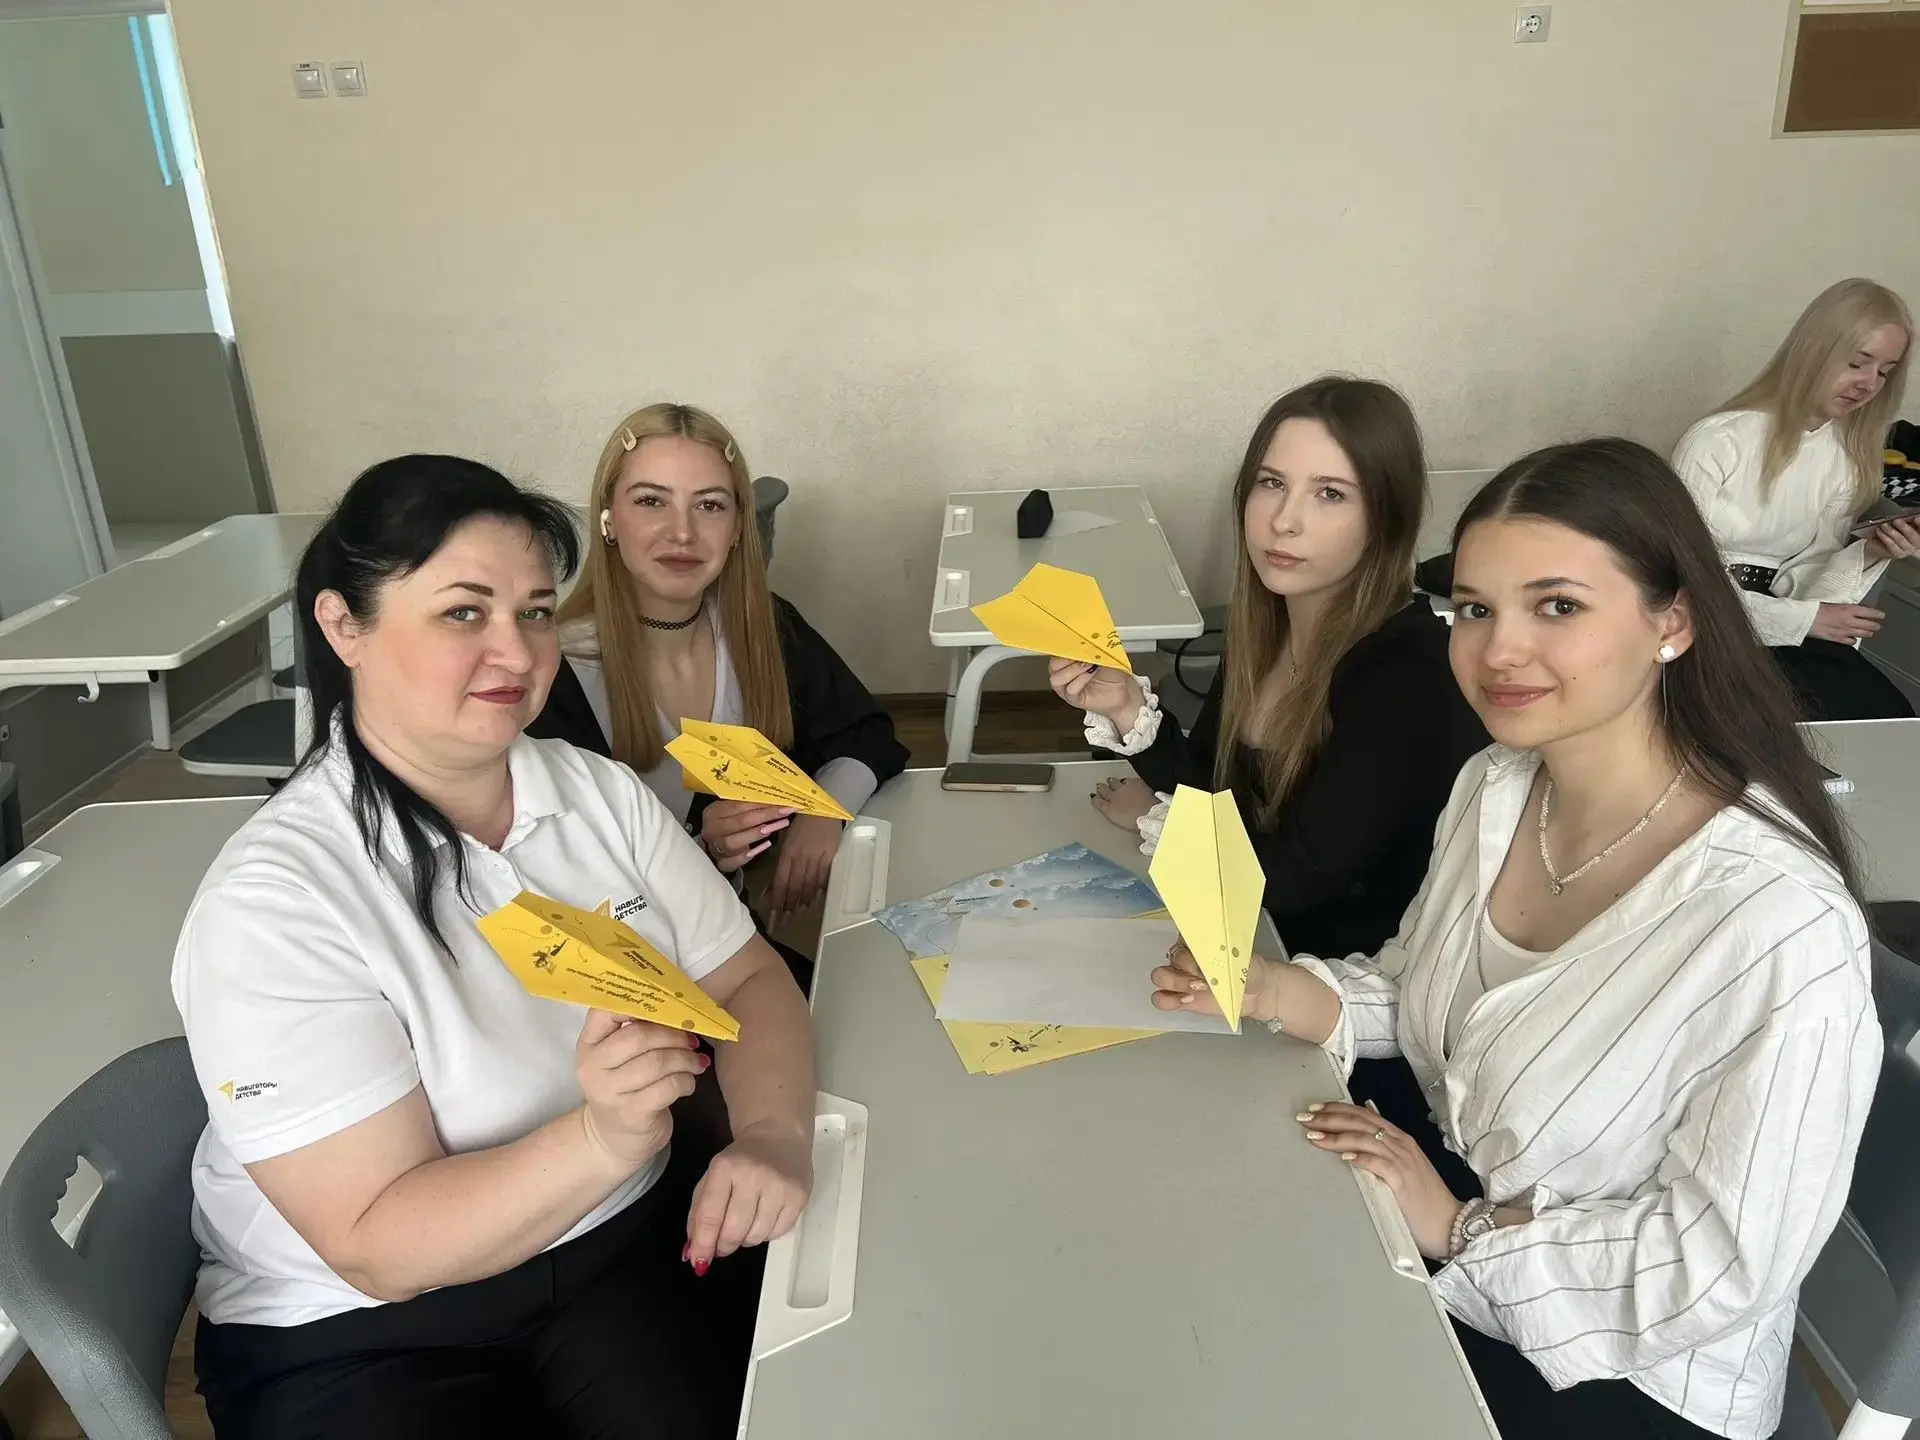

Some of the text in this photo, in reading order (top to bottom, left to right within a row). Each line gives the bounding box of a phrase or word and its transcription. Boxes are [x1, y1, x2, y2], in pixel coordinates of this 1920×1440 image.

[614, 901, 647, 920] ДЕТСТВА
[236, 1082, 277, 1092] НАВИГАТОРЫ
[235, 1090, 261, 1100] ДЕТСТВА
